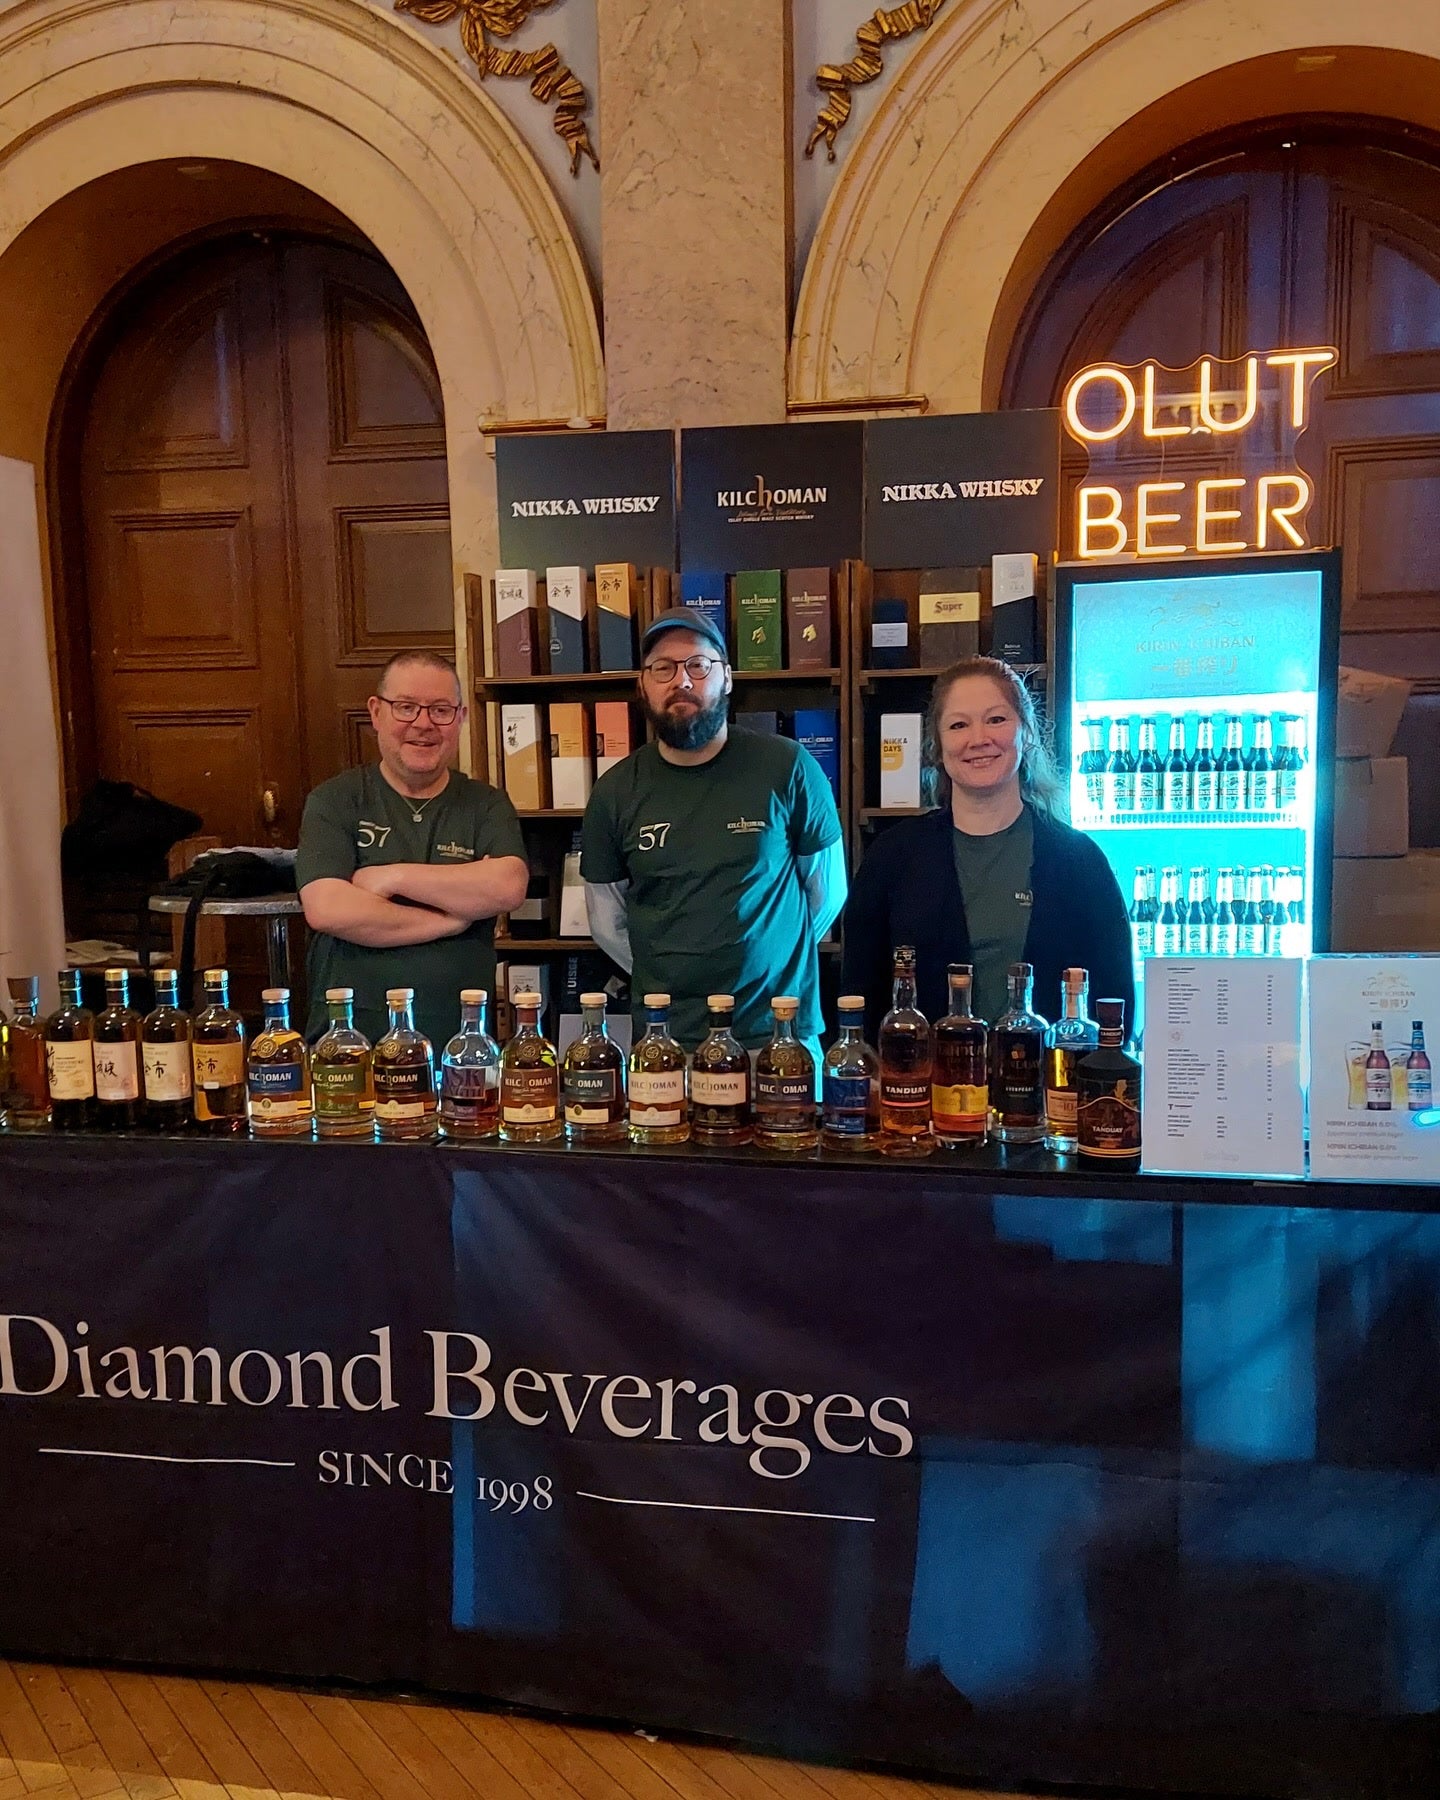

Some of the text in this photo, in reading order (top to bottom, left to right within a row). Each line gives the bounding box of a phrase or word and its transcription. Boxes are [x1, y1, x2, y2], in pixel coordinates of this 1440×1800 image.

[1066, 352, 1334, 441] OLUT
[882, 478, 1044, 502] NIKKA WHISKY
[511, 496, 660, 517] NIKKA WHISKY
[1078, 475, 1309, 559] BEER
[933, 601, 965, 614] Super
[883, 737, 908, 745] NIKKA
[883, 745, 902, 753] DAYS
[357, 820, 391, 848] 57
[638, 822, 671, 851] 57
[886, 1086, 927, 1094] TANDUAY
[1092, 1125, 1124, 1133] TANDUAY
[0, 1314, 914, 1480] Diamond Beverages
[318, 1450, 554, 1515] SINCE 1998
